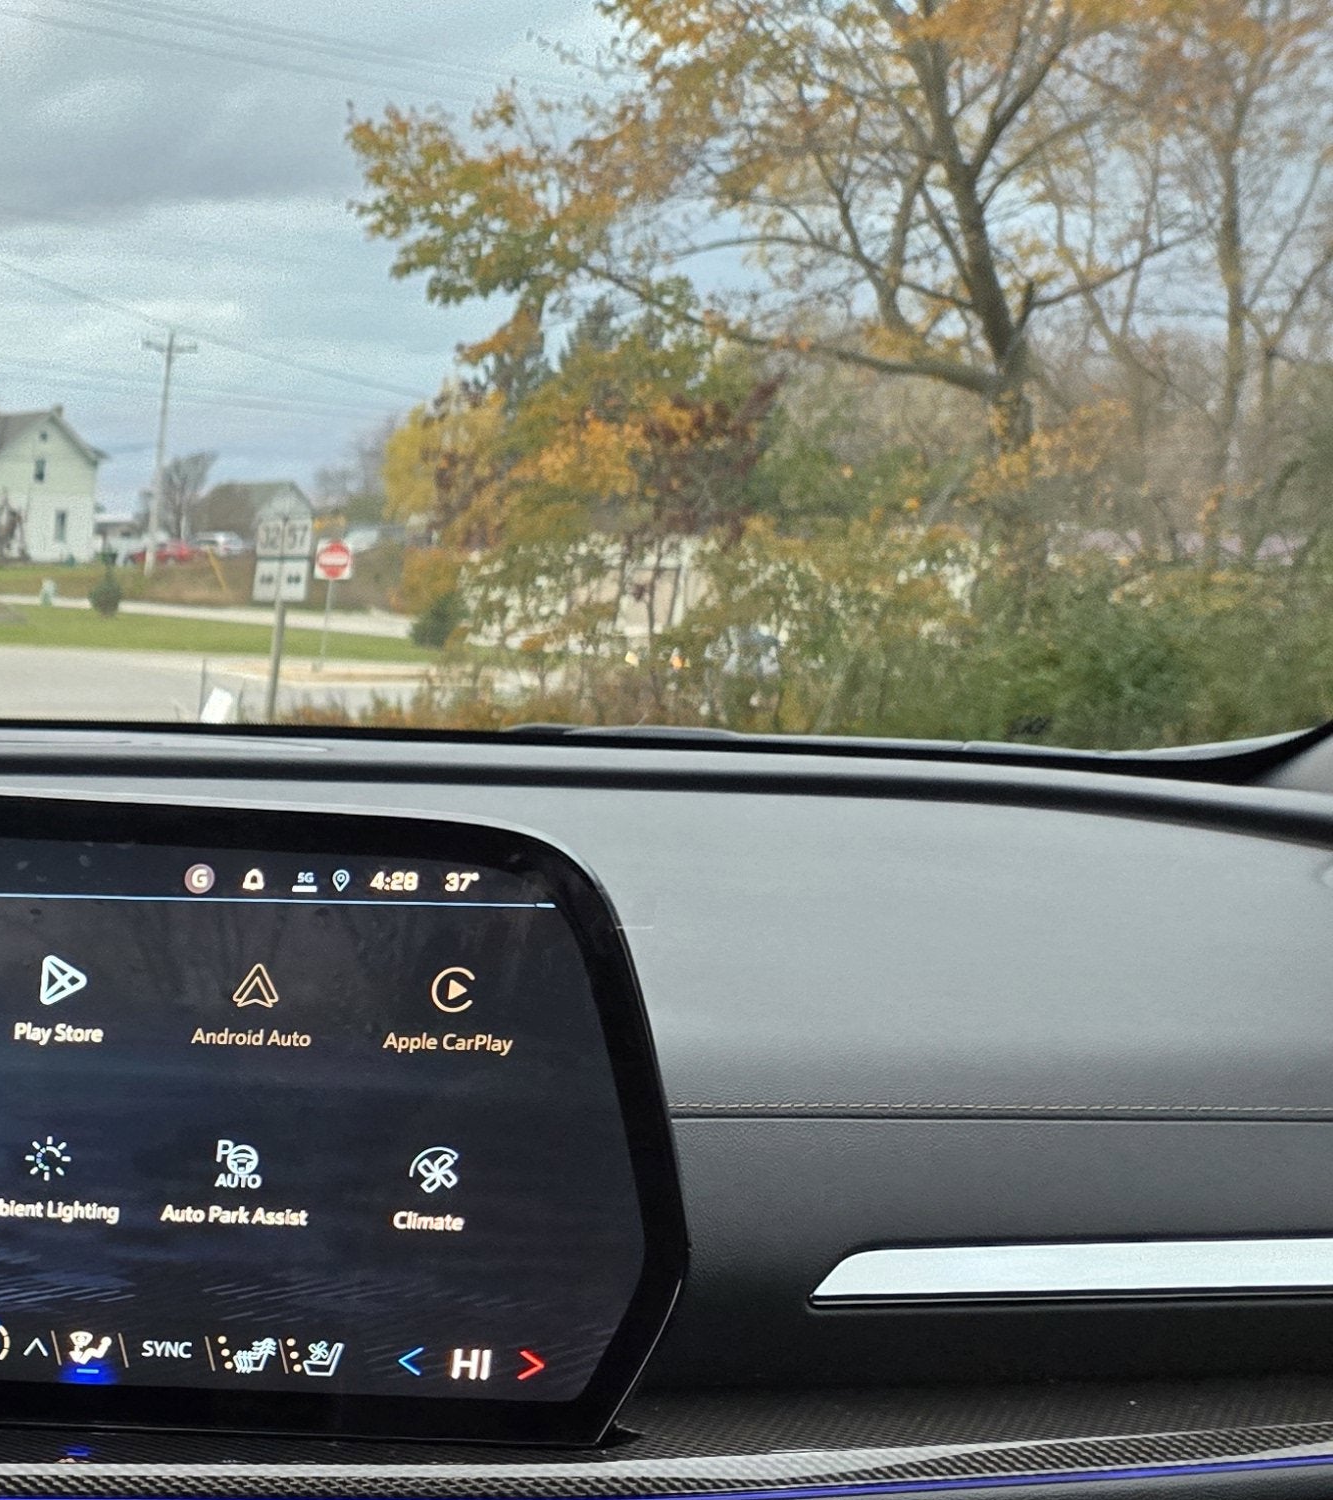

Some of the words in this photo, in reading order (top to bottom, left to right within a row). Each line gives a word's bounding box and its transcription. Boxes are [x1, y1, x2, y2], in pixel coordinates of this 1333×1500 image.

[297, 871, 315, 884] 5G
[369, 870, 419, 892] 4:28
[13, 1022, 52, 1045] Play
[54, 1023, 104, 1044] Store
[191, 1027, 263, 1048] Android
[267, 1029, 312, 1048] Auto
[382, 1031, 438, 1053] Apple
[442, 1032, 514, 1056] CarPlay
[214, 1173, 262, 1190] AUTO
[46, 1200, 121, 1224] Lighting
[160, 1203, 204, 1225] Auto
[208, 1205, 250, 1226] Park
[251, 1206, 308, 1227] Assist
[392, 1211, 465, 1232] Climate
[141, 1338, 193, 1361] SYNC
[449, 1348, 493, 1381] HI
